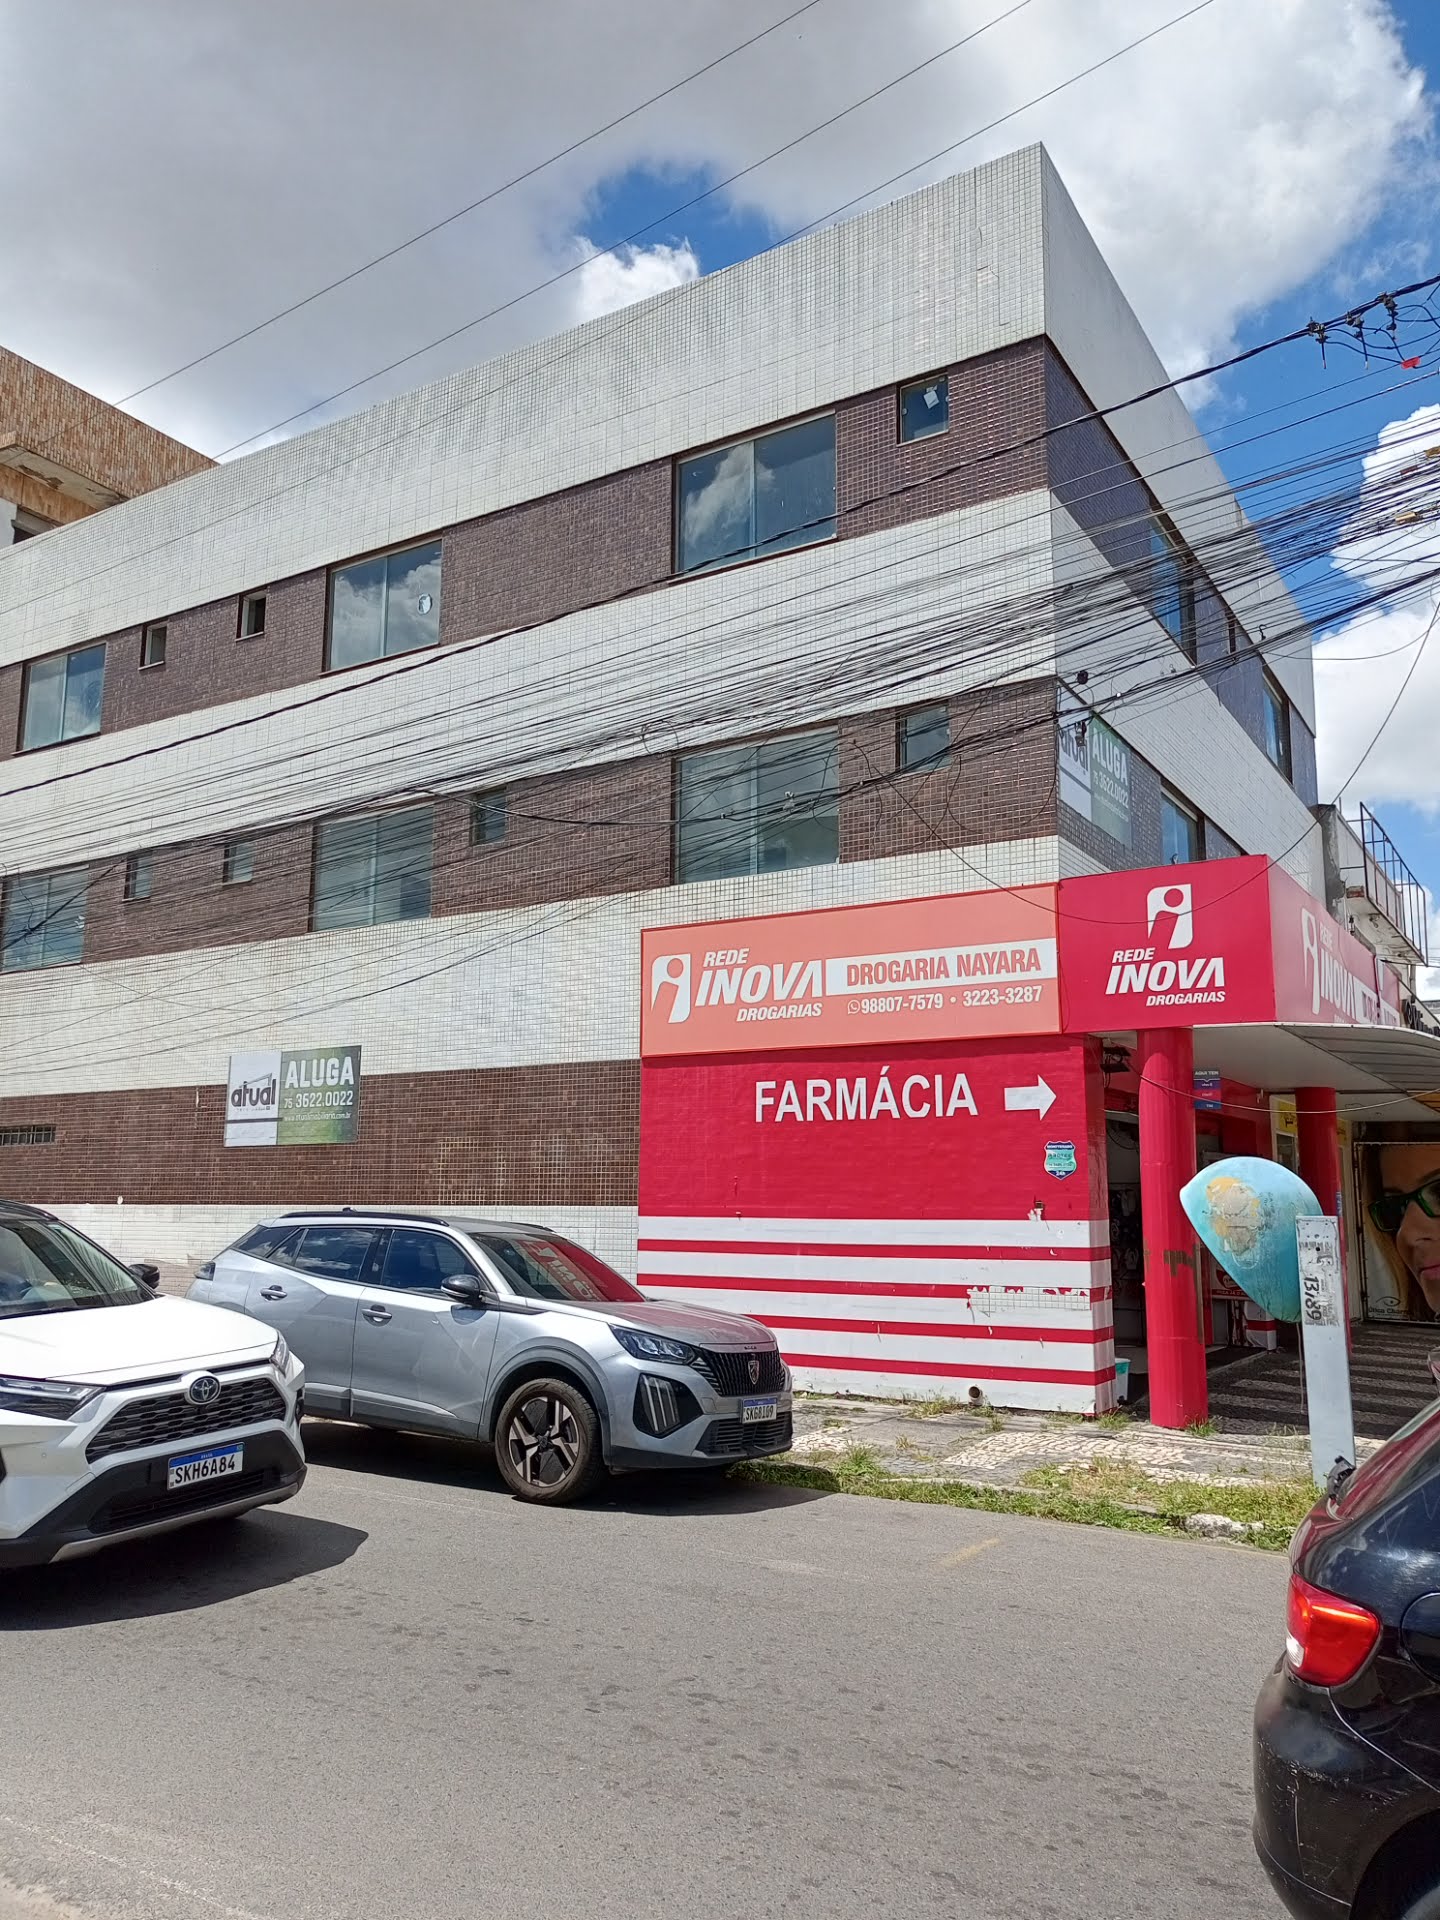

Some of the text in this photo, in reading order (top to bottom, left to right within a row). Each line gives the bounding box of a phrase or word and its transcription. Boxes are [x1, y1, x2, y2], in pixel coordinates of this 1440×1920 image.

[1092, 727, 1128, 786] ALUGA
[703, 948, 749, 967] REDE
[847, 948, 1041, 986] DROGARIA NAYARA
[1112, 947, 1155, 963] REDE
[695, 959, 823, 1006] INOVA
[1105, 957, 1225, 995] INOVA
[1320, 947, 1357, 1021] INOVA
[736, 1003, 823, 1022] DROGARIAS
[861, 986, 1042, 1014] 98807-7579 3223-3287
[1146, 991, 1226, 1007] DROGARIAS
[285, 1056, 355, 1089] ALUGA
[231, 1078, 277, 1107] atual
[284, 1090, 353, 1109] 75 3622.0022
[755, 1065, 978, 1122] FARMÁCIA
[174, 1454, 236, 1484] SKH6A84
